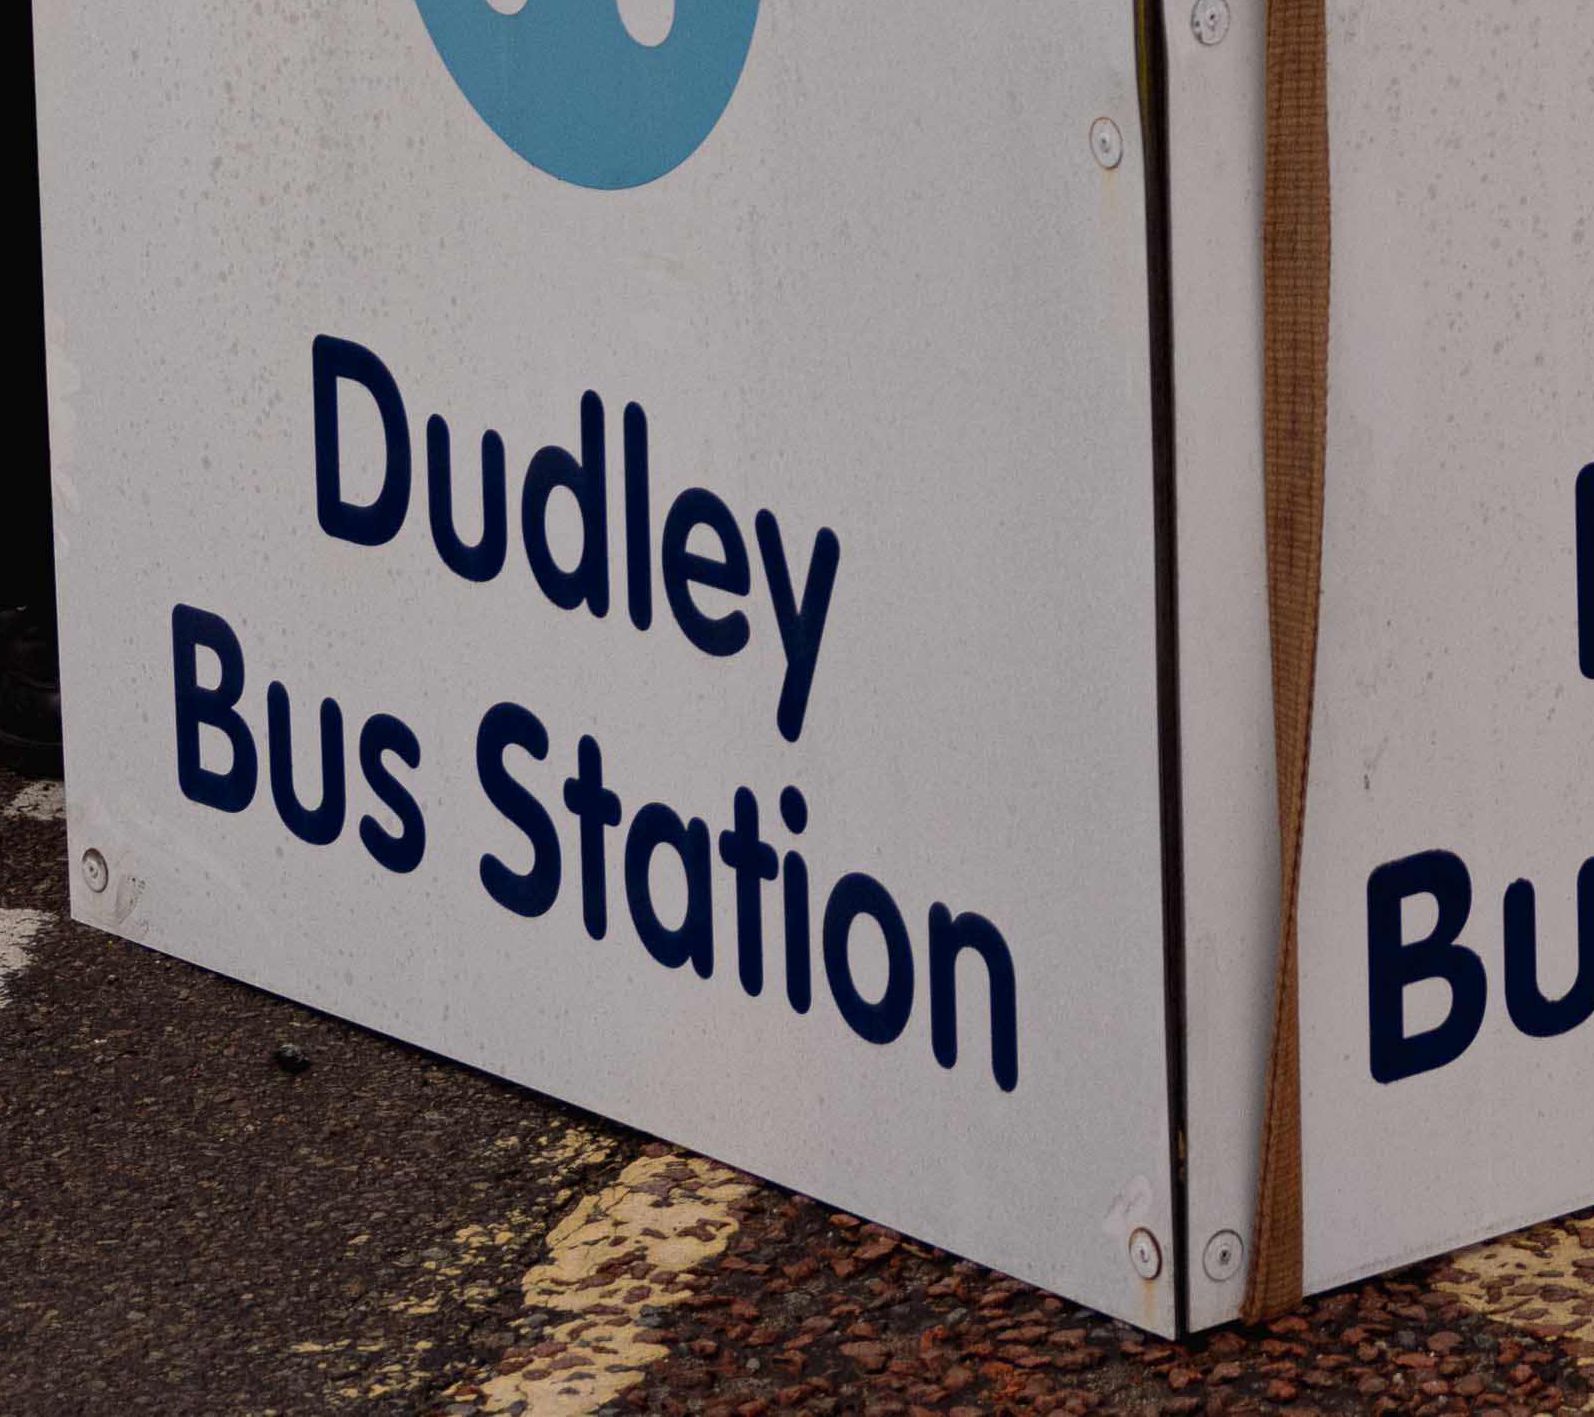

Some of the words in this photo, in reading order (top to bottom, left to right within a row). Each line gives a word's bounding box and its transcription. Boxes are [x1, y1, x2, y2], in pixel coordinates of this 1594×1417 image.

[312, 333, 840, 743] Dudley
[171, 602, 427, 875] Bus
[475, 700, 1019, 1093] Station
